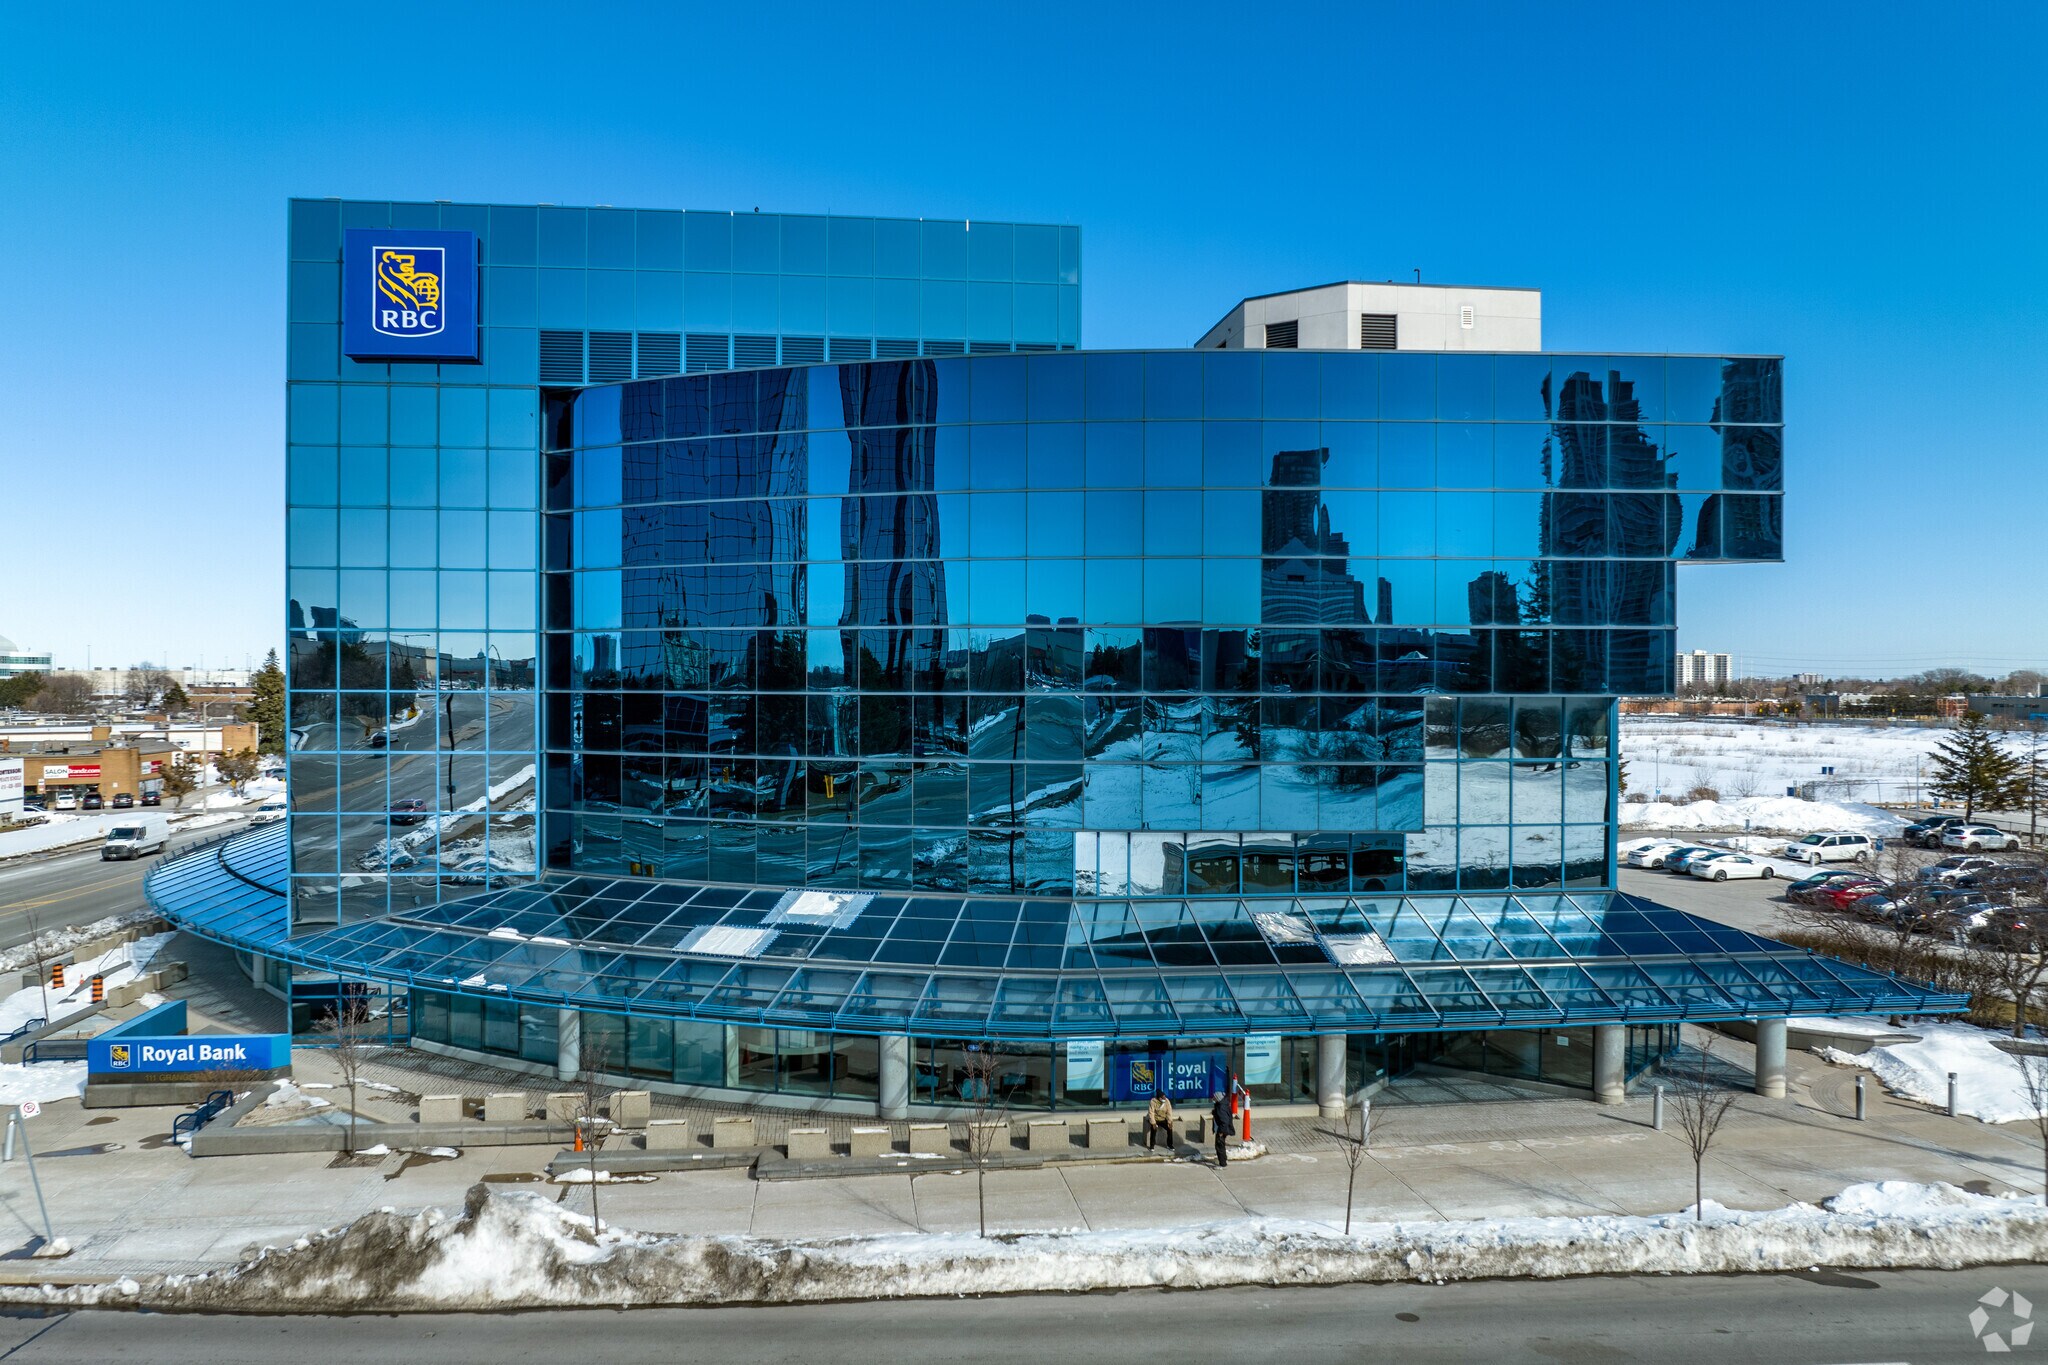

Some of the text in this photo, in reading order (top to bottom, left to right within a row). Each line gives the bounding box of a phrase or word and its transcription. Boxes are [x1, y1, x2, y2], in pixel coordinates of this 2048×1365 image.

[381, 309, 437, 329] RBC
[142, 1043, 247, 1066] Royal Bank
[1168, 1060, 1207, 1078] Royal
[1133, 1083, 1153, 1091] RBC
[1168, 1076, 1203, 1090] Bank
